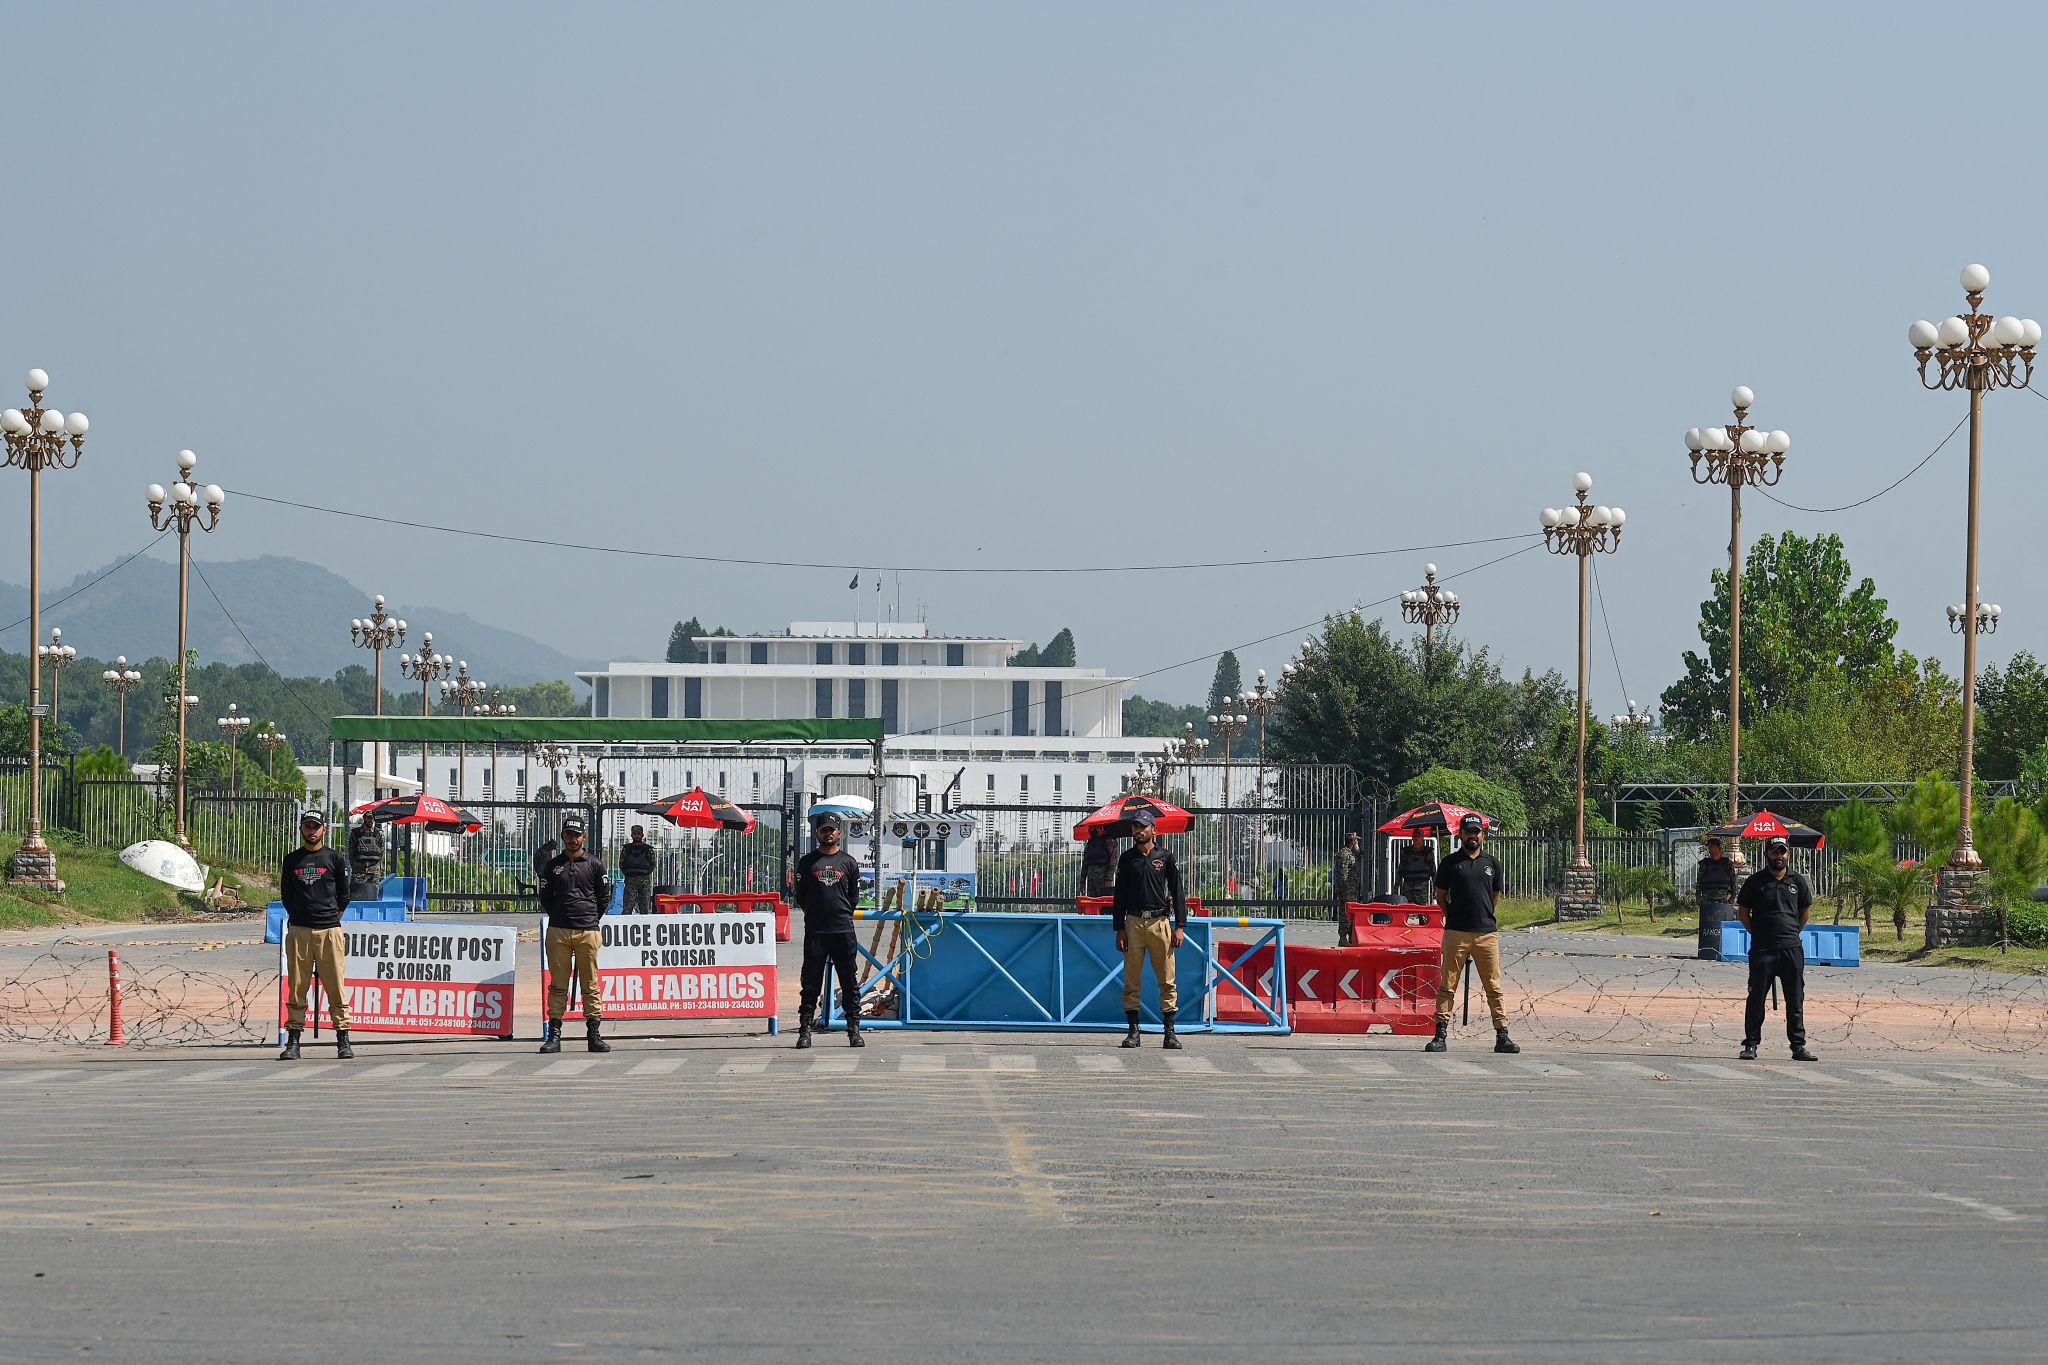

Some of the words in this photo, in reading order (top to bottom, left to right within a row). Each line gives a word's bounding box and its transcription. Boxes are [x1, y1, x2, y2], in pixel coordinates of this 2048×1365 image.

[602, 924, 652, 947] OLICE
[656, 922, 716, 945] CHECK
[720, 922, 766, 944] POST
[393, 934, 452, 960] CHECK
[457, 937, 504, 962] POST
[641, 950, 658, 967] PS
[661, 949, 716, 967] KOHSAR
[377, 962, 394, 979] PS
[397, 963, 451, 982] KOHSAR
[650, 972, 765, 1001] FABRICS
[388, 987, 503, 1019] FABRICS
[607, 1003, 625, 1012] AREA
[670, 1002, 682, 1010] PH:
[683, 1000, 765, 1010] 051-2348100-2348200
[406, 1017, 418, 1026] PH:
[419, 1018, 501, 1030] 051-2348100-2348200
